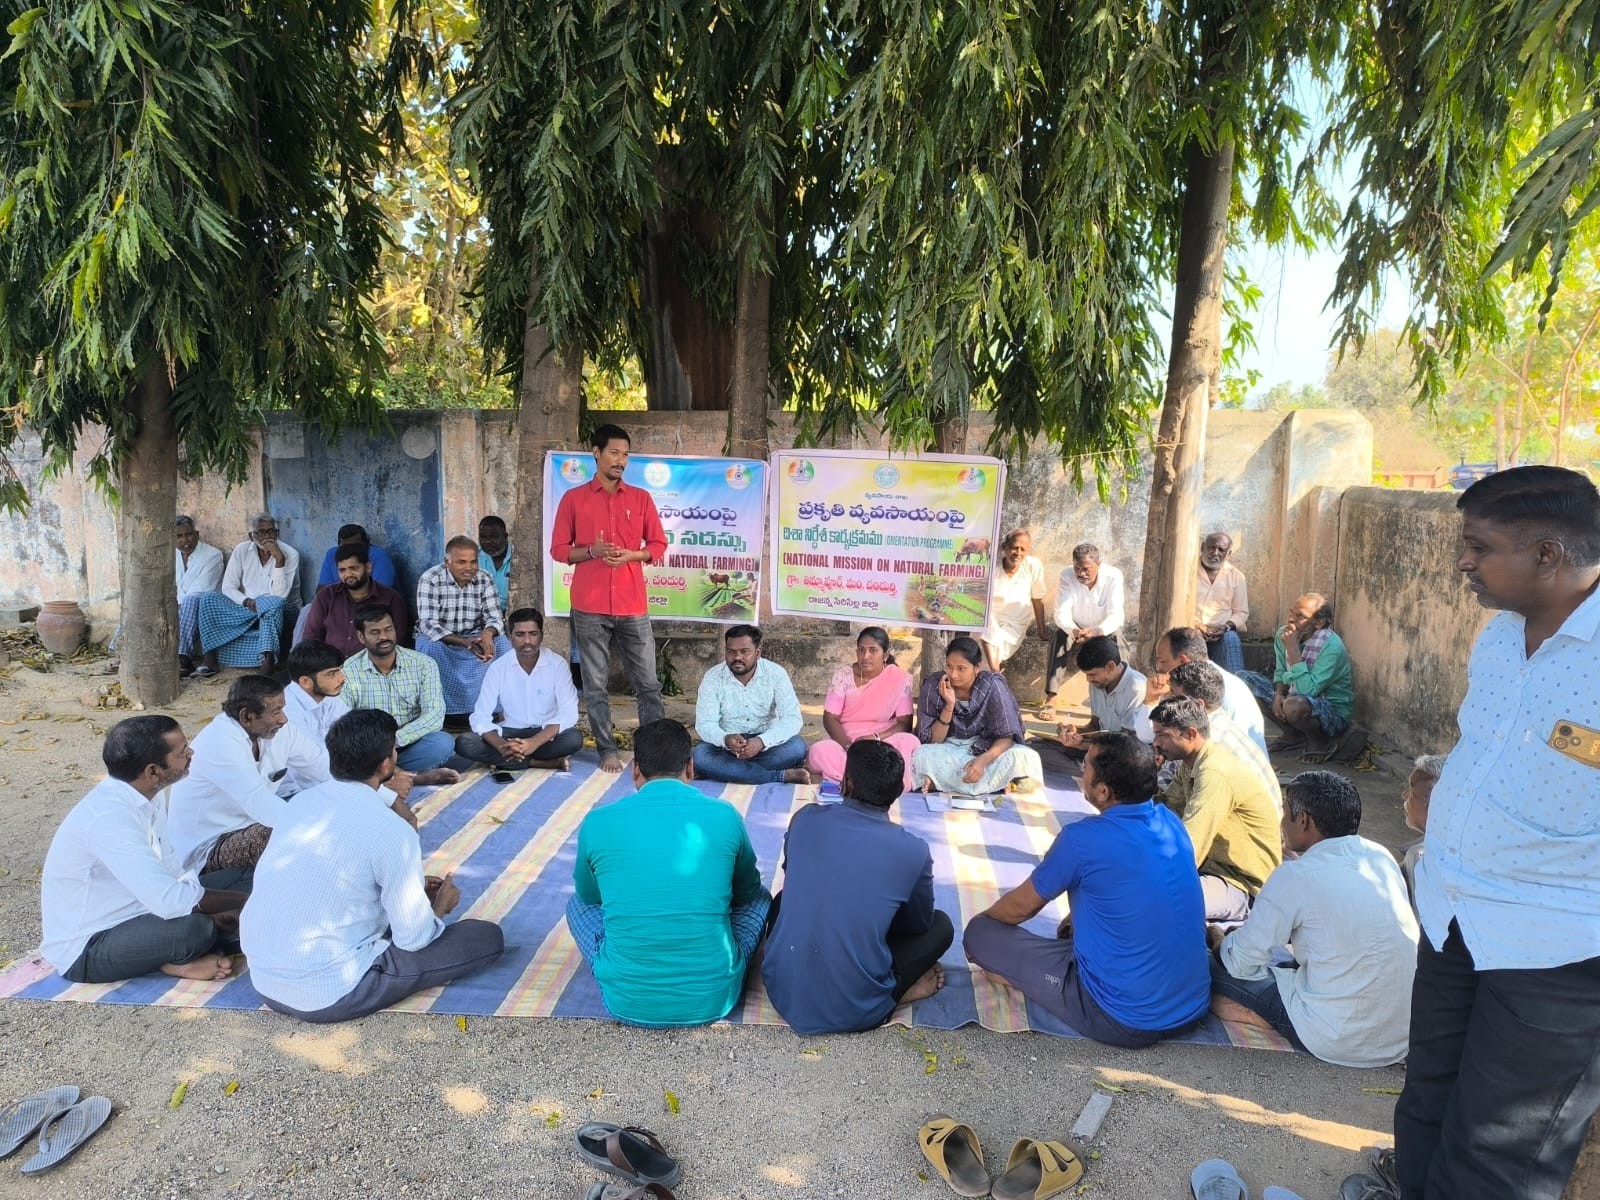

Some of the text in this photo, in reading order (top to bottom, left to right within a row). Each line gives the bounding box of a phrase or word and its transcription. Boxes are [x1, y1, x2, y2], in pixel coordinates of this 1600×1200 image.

[659, 505, 737, 527] సాయంపై
[798, 501, 966, 529] ప్రకృతి వ్యవసాయంపై
[681, 530, 747, 552] సదస్సు
[783, 527, 803, 541] దిశా
[669, 553, 709, 570] NATURAL
[712, 555, 755, 572] FARMING)
[783, 553, 986, 578] (NATIONAL MISSION ON NATURAL FARMING)
